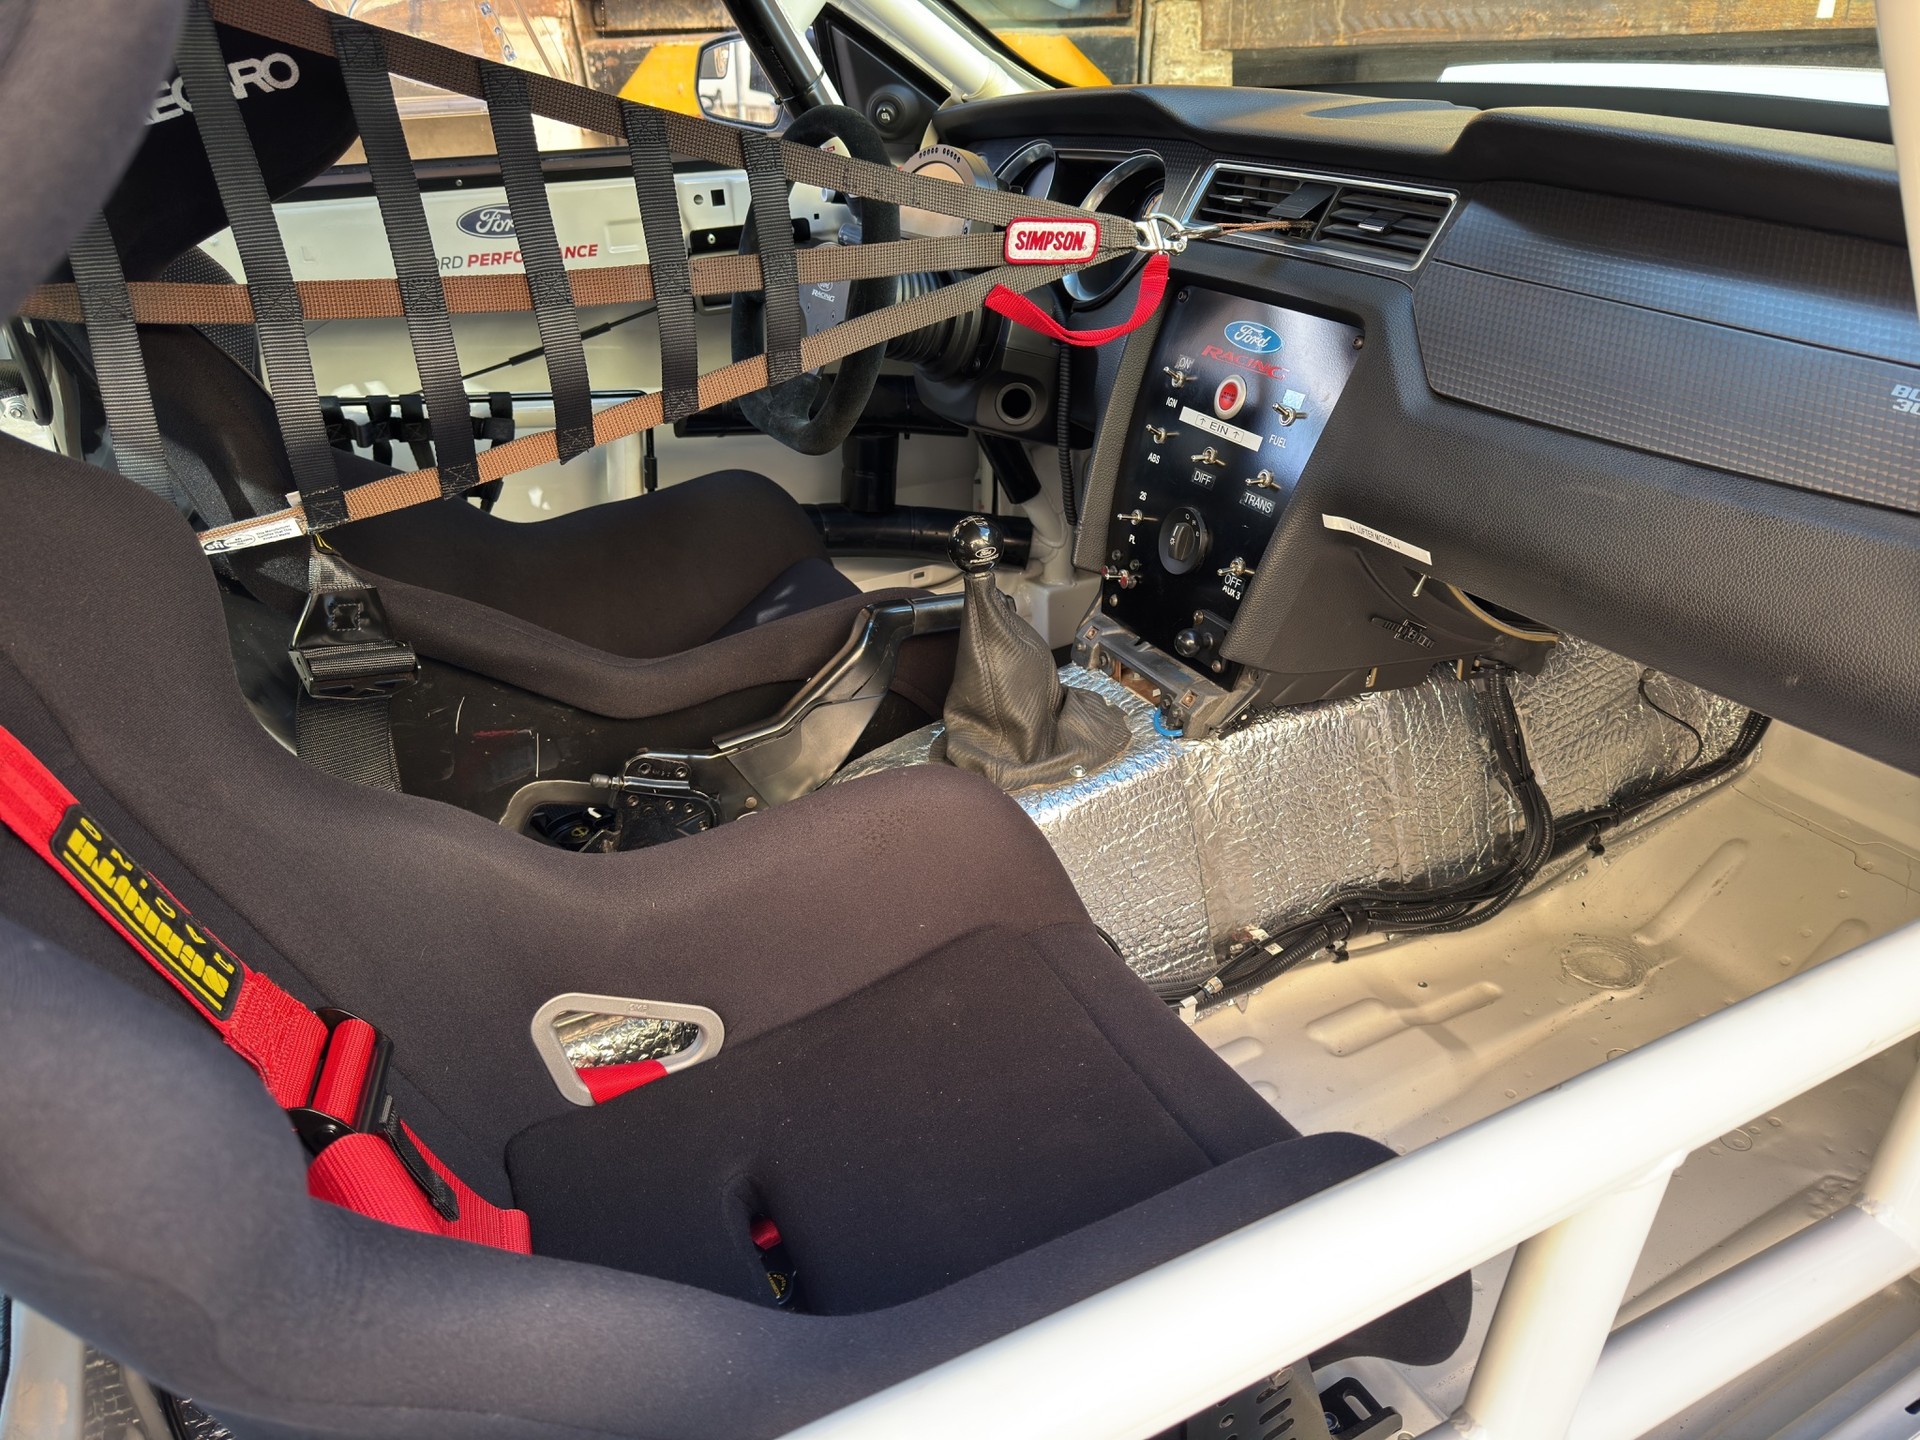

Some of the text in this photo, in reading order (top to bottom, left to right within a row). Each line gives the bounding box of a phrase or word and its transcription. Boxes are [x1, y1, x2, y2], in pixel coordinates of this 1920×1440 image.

[145, 52, 300, 125] ECRO
[475, 208, 515, 234] For
[1015, 231, 1086, 251] SIMPSON
[467, 244, 598, 267] PERFONCE
[1234, 324, 1272, 348] Ford
[1202, 344, 1290, 381] RACING
[1165, 396, 1179, 409] IGN
[1209, 421, 1229, 436] EIN
[1268, 434, 1287, 449] FUEL
[1147, 452, 1161, 464] ABS
[1193, 470, 1213, 486] DIFF
[1243, 492, 1273, 514] TRANS
[1221, 584, 1241, 600] AUX 3
[1224, 574, 1242, 590] OFF
[79, 816, 236, 975] RACING
